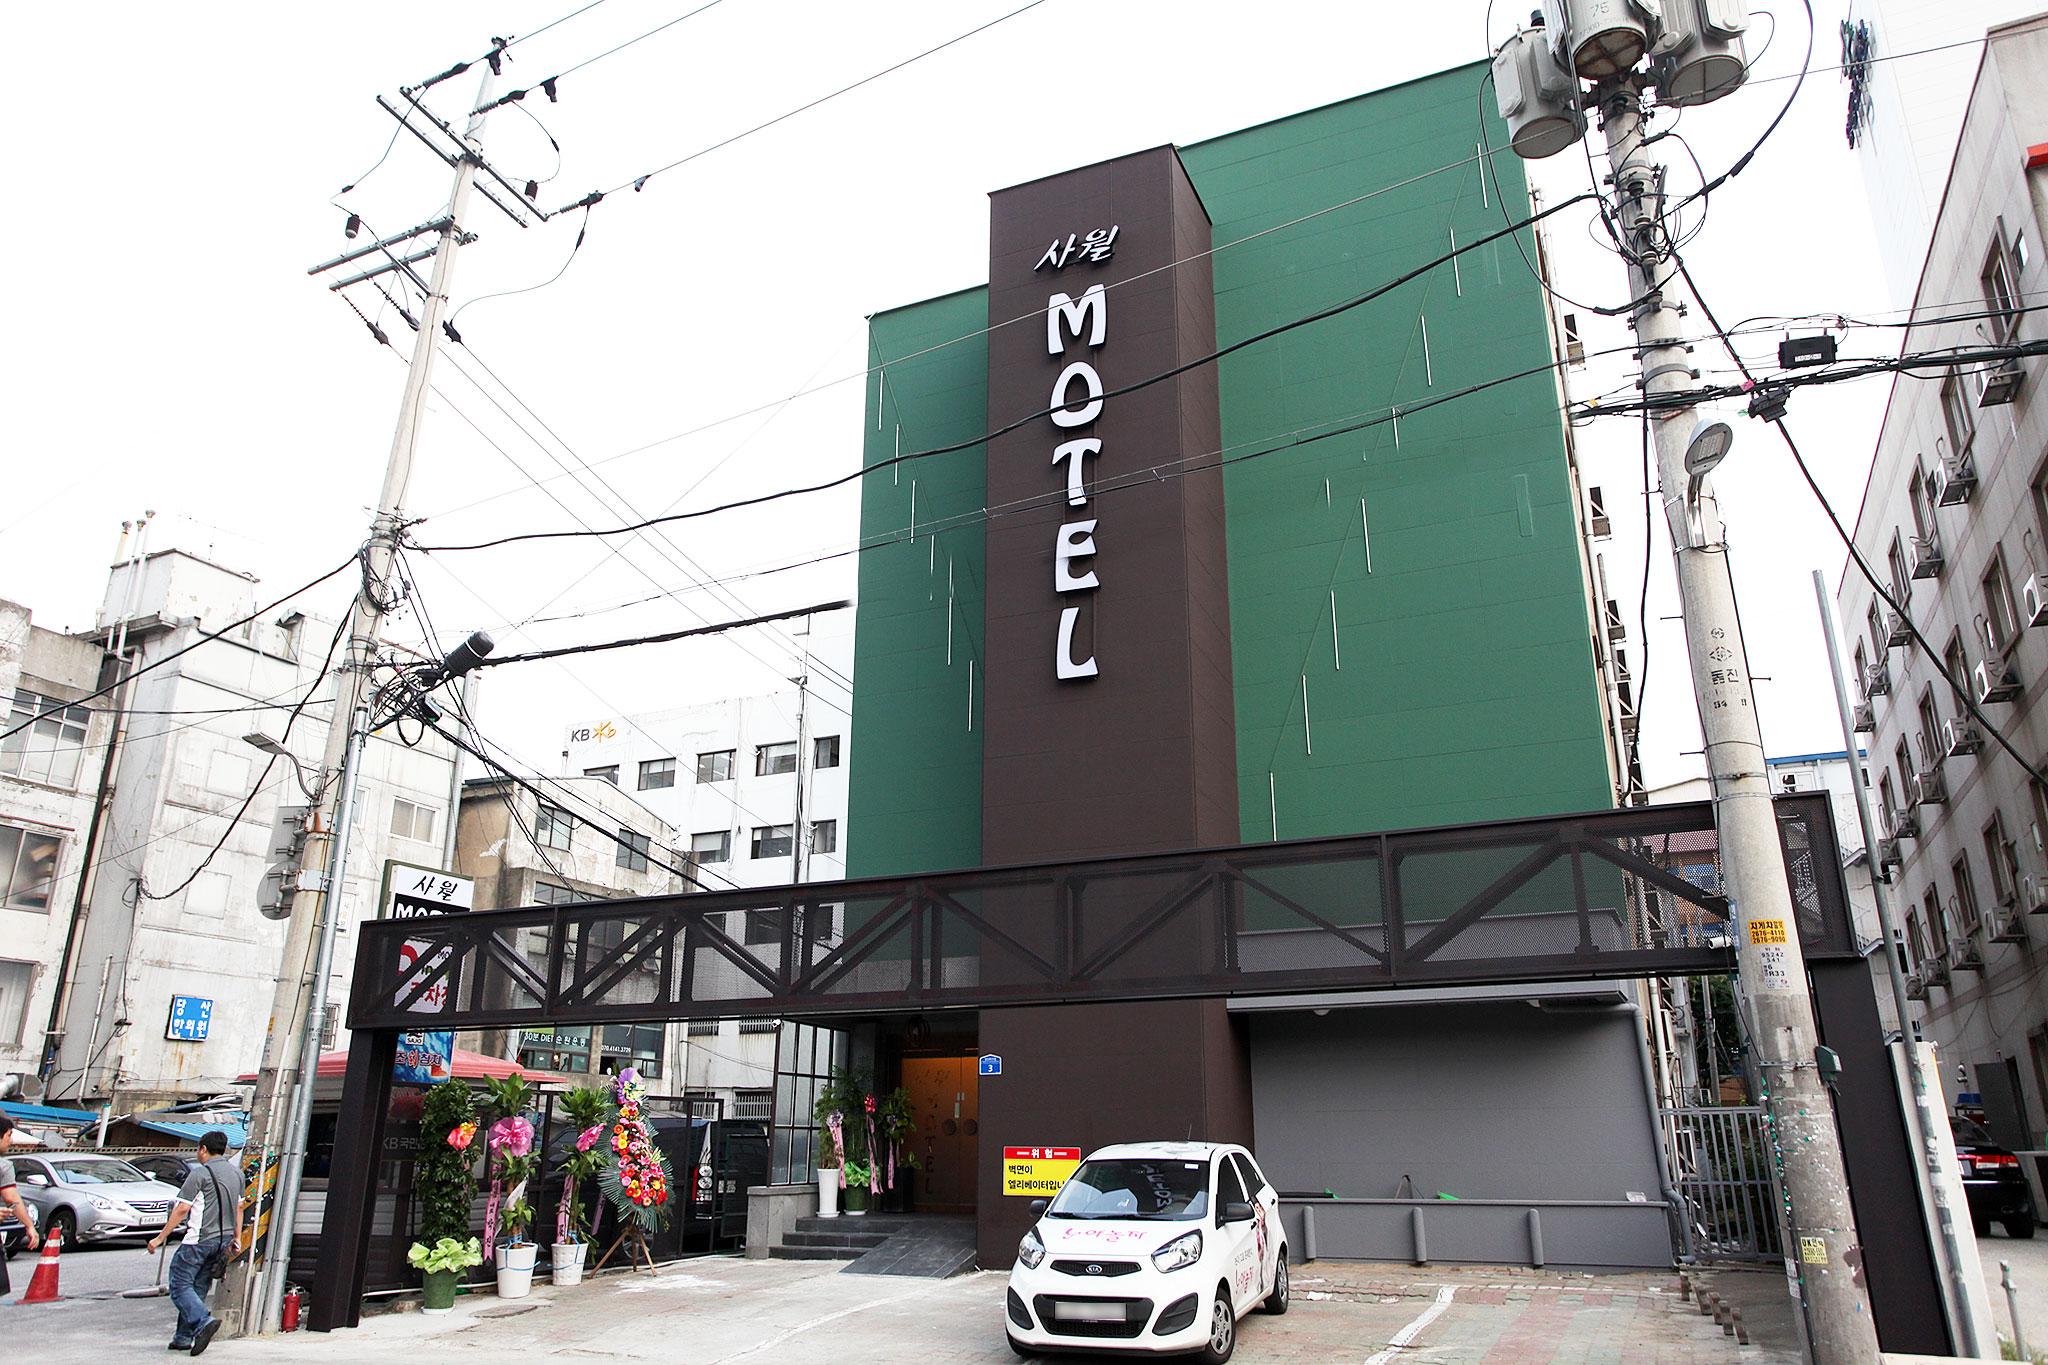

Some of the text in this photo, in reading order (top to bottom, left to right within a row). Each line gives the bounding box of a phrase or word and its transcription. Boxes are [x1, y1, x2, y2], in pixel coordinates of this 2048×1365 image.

[1034, 225, 1120, 272] 사월
[1046, 283, 1107, 681] MOTEL
[571, 729, 590, 742] KB
[412, 875, 458, 901] 사월
[174, 1019, 208, 1038] 한의원
[987, 1064, 994, 1073] 3
[1031, 1148, 1053, 1159] 위험
[1008, 1165, 1033, 1175] 벽면이
[1086, 1265, 1102, 1274] KIA
